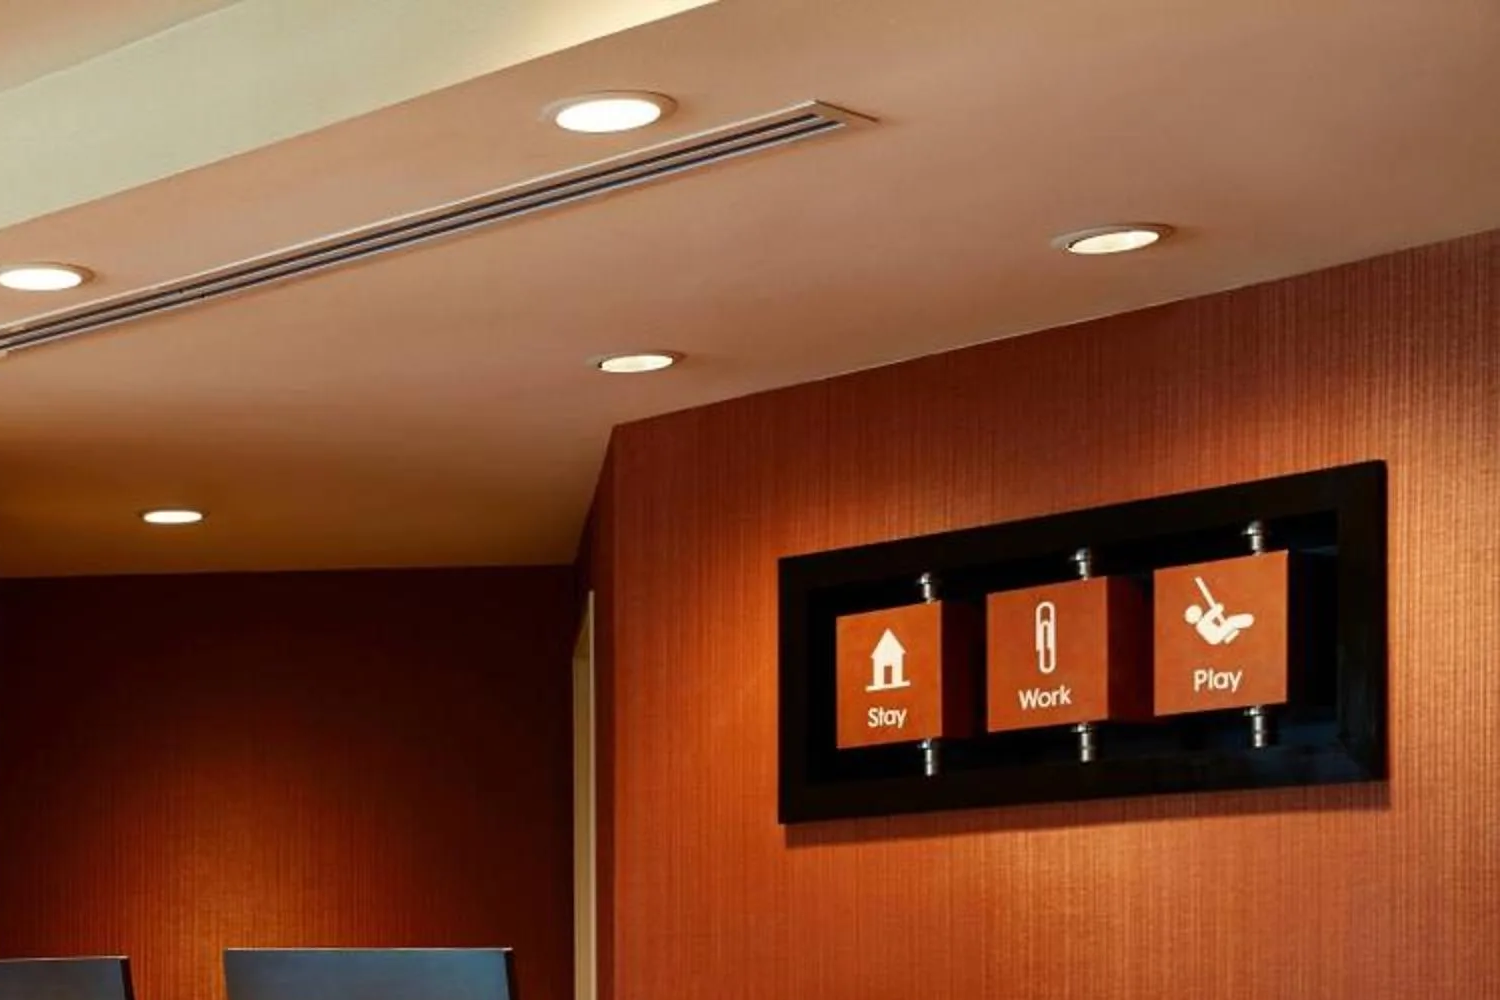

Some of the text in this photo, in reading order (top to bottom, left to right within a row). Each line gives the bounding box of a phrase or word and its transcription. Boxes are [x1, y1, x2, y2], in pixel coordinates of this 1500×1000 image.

[1194, 668, 1243, 693] Play
[1019, 685, 1071, 711] Work
[867, 704, 907, 729] Stay
